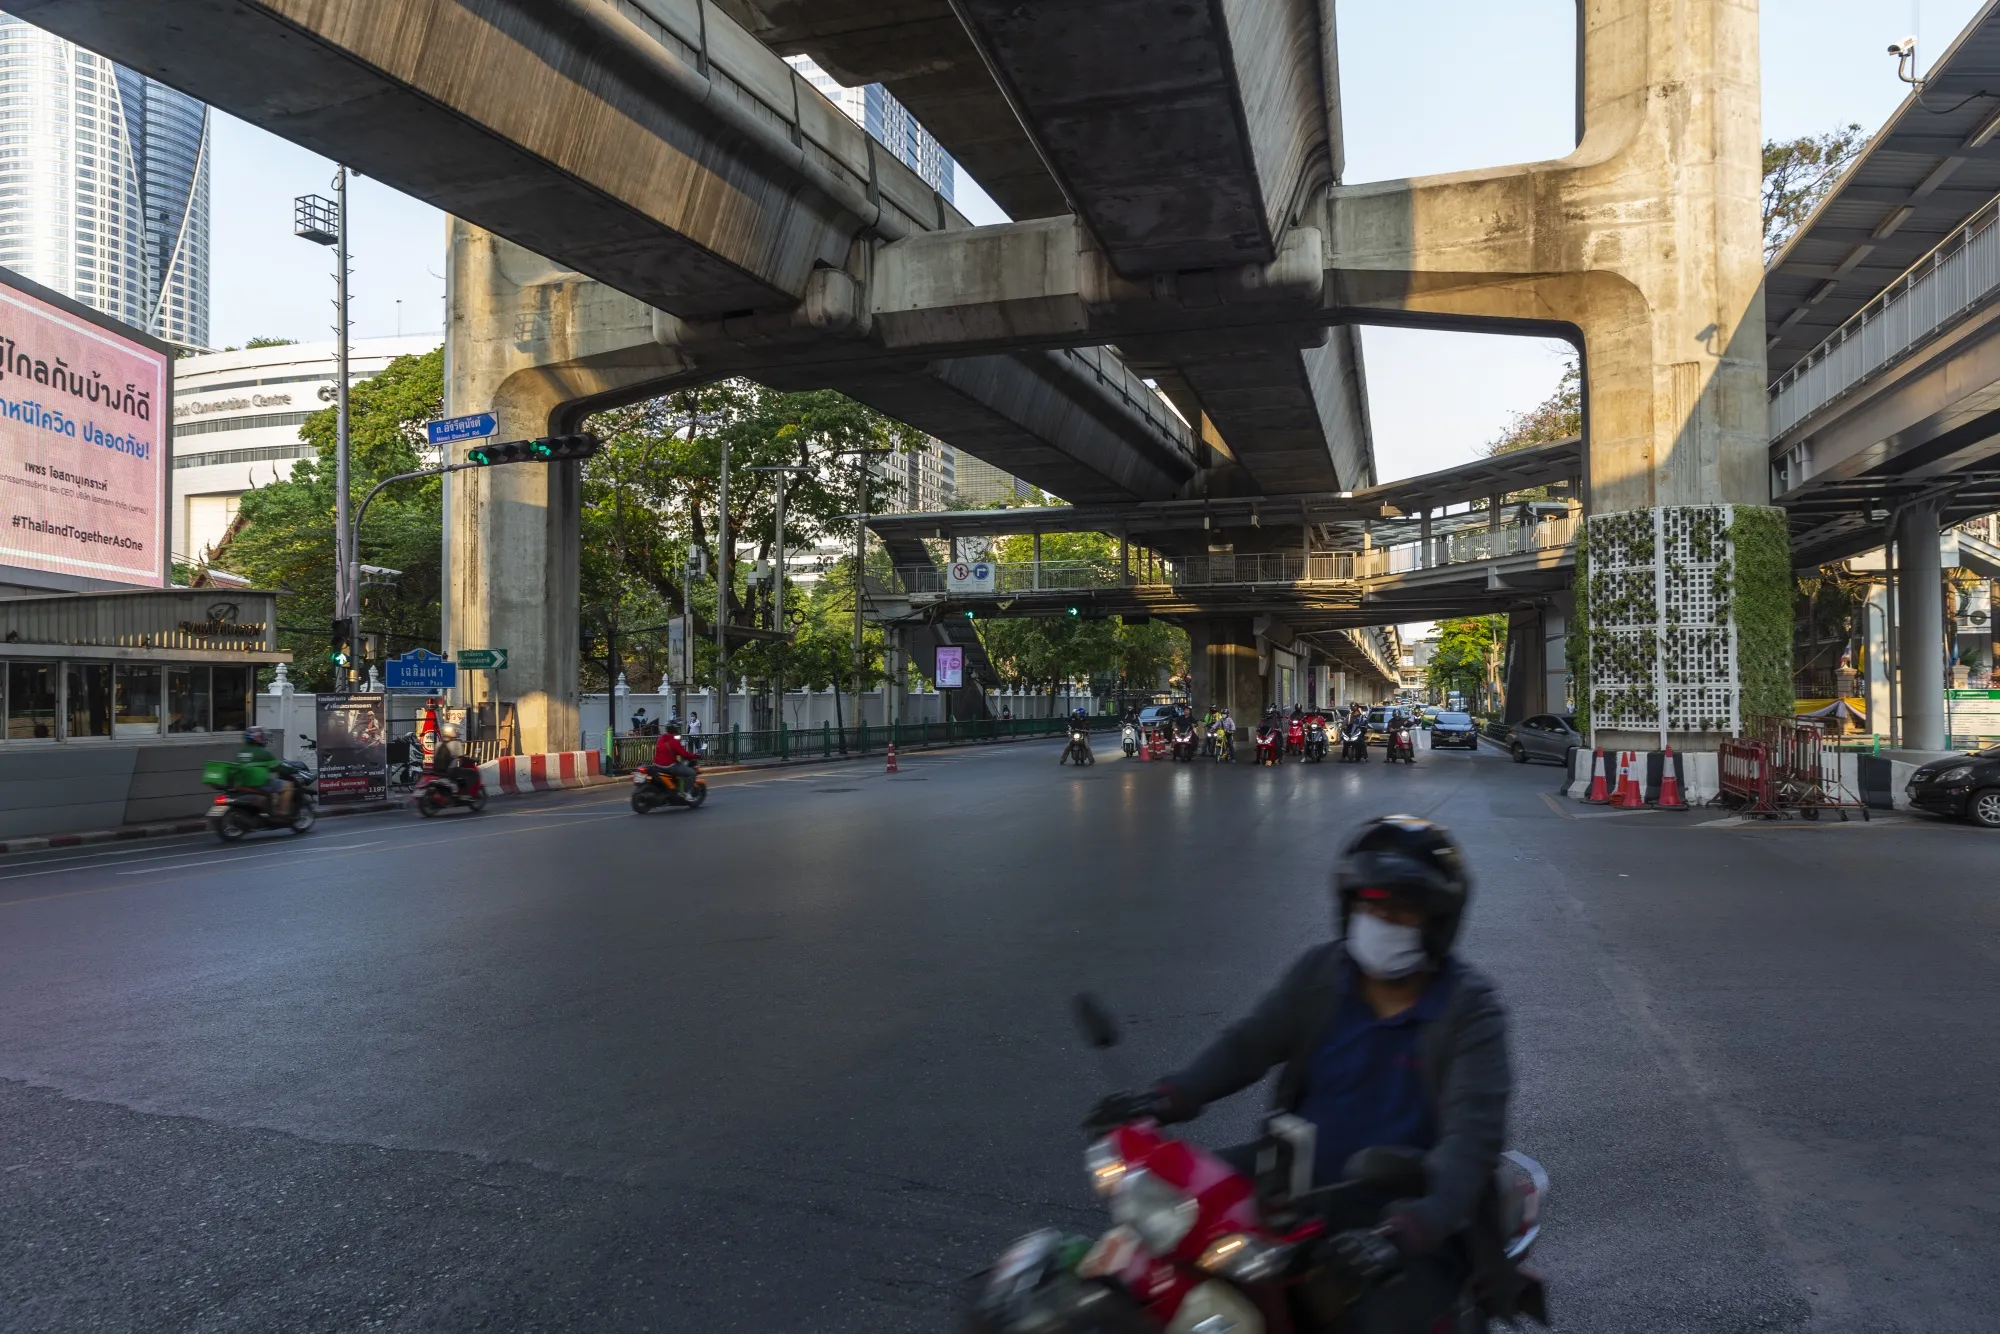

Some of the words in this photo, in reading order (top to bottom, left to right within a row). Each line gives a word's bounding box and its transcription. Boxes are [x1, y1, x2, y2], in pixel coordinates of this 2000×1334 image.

[252, 394, 292, 408] Centre
[83, 421, 149, 460] ปลอดภัย!
[24, 462, 46, 476] เพชร
[50, 465, 108, 491] โอสถานุเคราะห์
[12, 515, 143, 551] #ThailandTogetherAsOne
